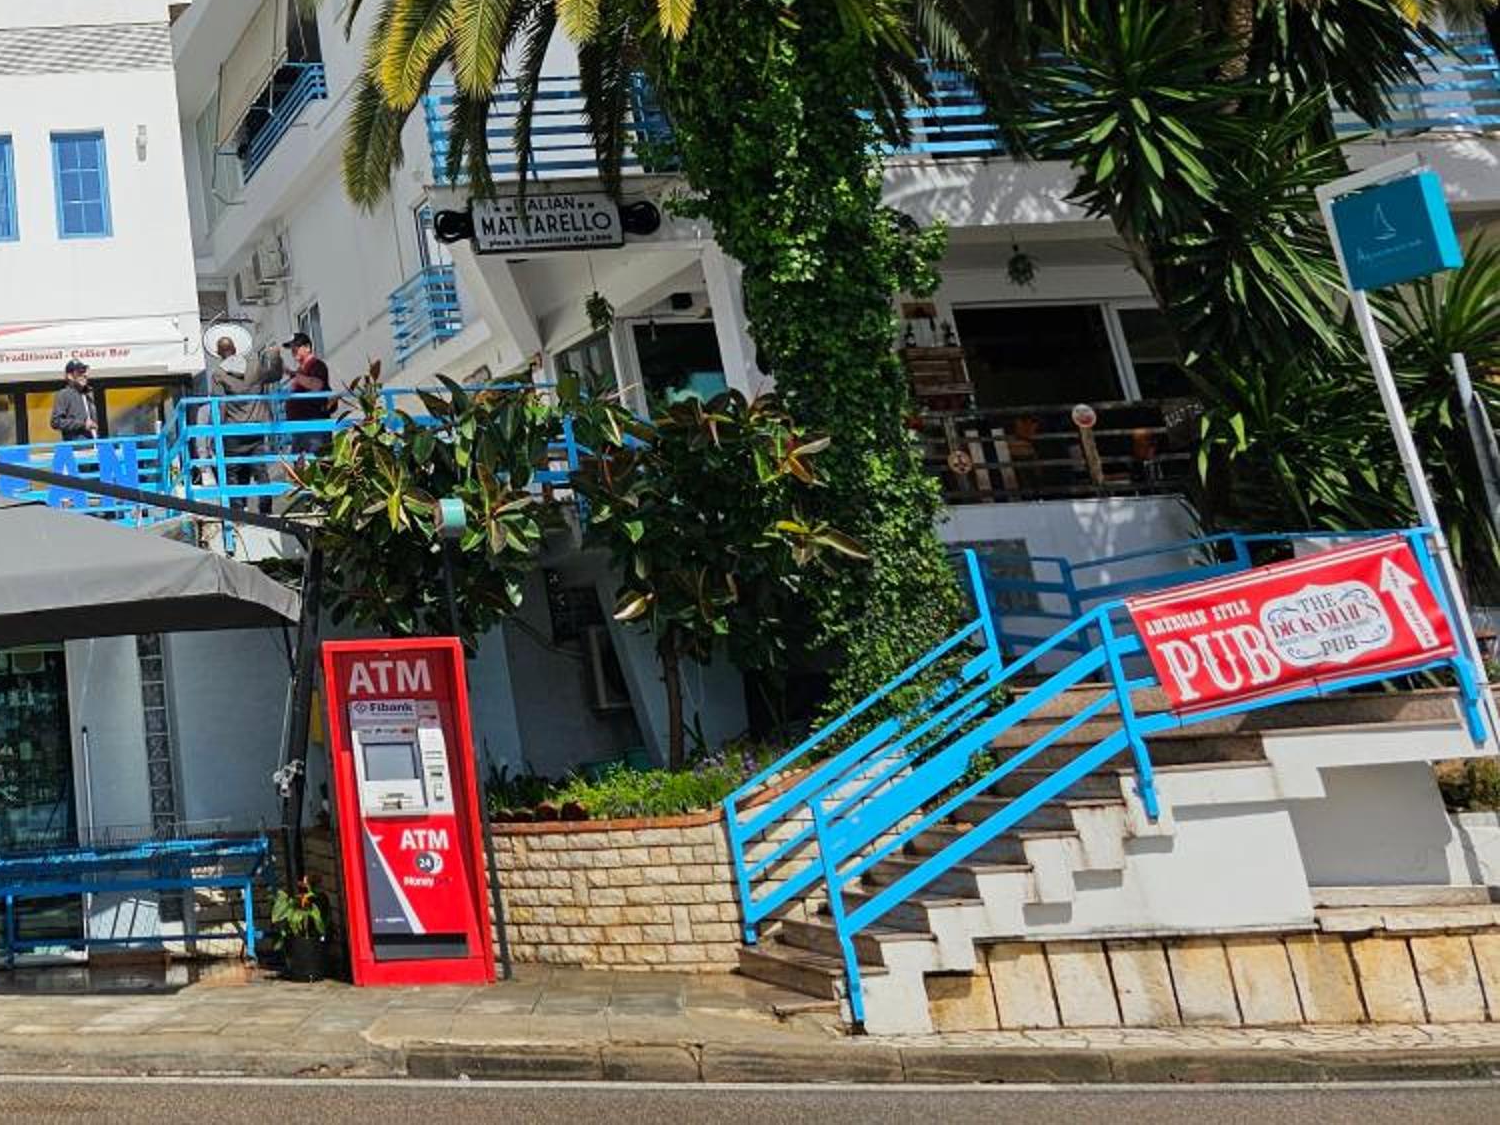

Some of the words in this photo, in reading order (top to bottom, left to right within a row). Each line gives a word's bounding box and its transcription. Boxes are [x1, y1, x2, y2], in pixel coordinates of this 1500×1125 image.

[0, 350, 63, 363] Traditional
[110, 347, 130, 357] Bar
[1300, 593, 1333, 614] THE
[1144, 608, 1208, 637] AMERICAN
[1211, 599, 1252, 622] STYLE
[1320, 634, 1358, 656] PUB
[1155, 624, 1281, 701] PUB
[348, 659, 432, 695] ATM
[400, 828, 450, 850] ATM
